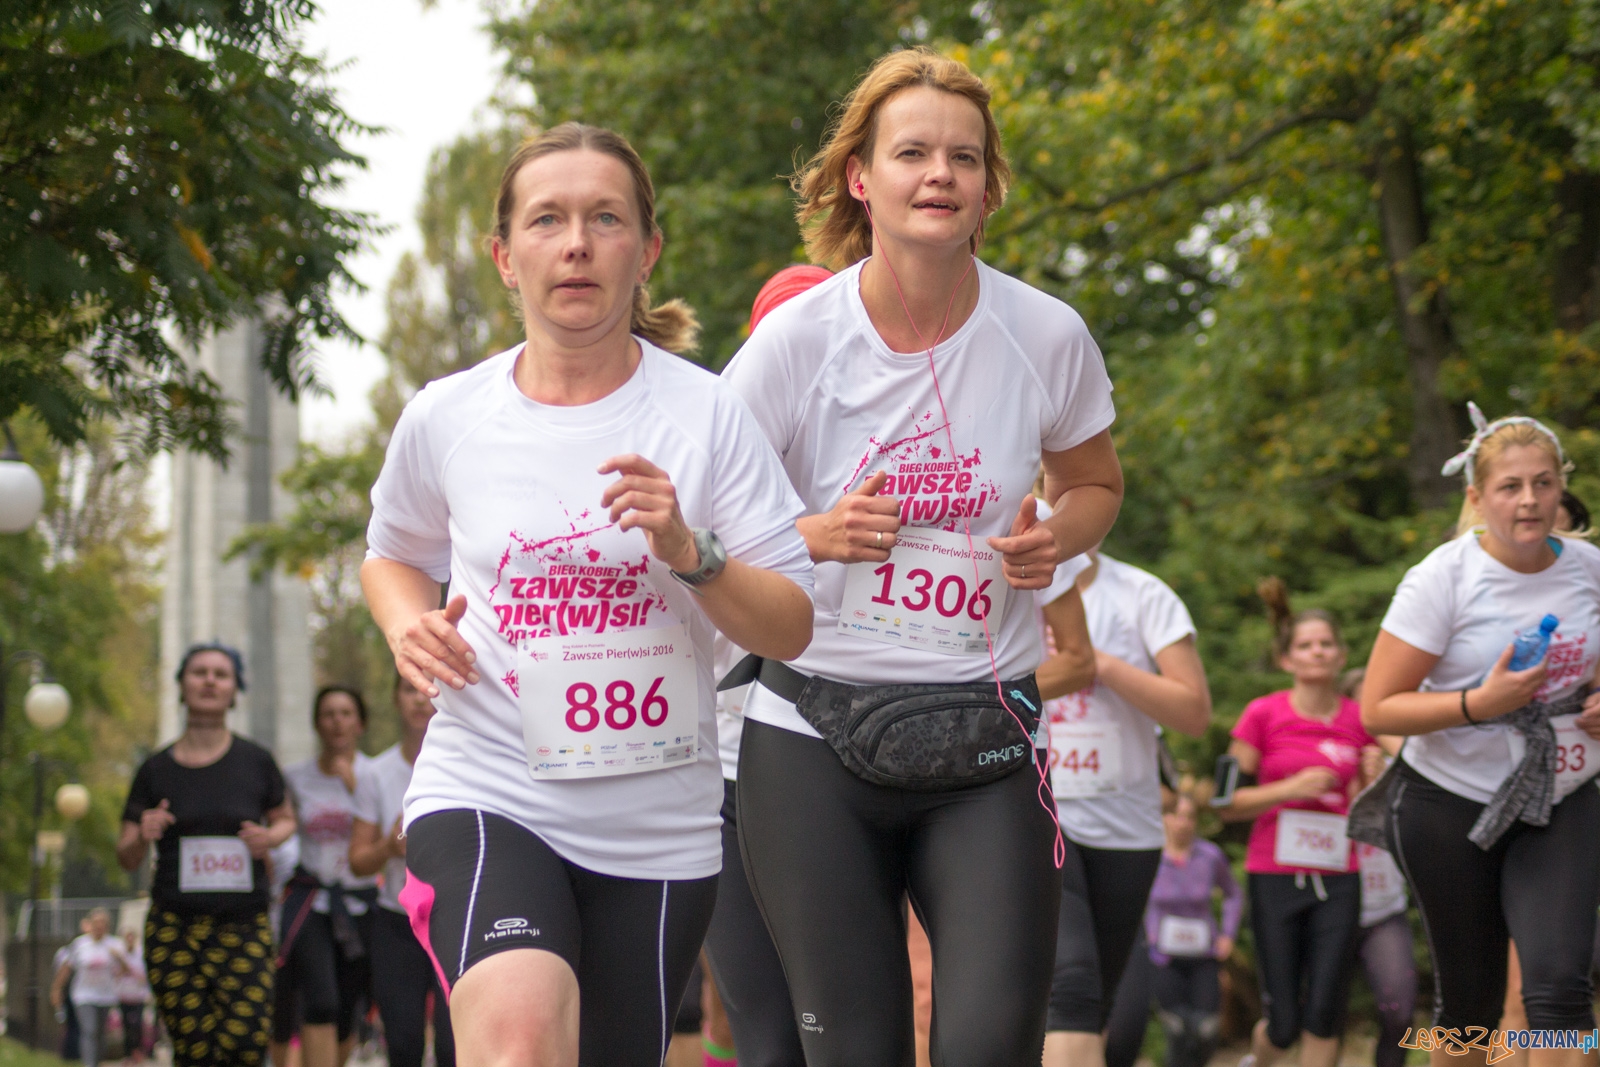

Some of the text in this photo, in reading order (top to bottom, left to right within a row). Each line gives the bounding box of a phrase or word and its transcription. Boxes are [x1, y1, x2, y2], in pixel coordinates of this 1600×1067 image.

[898, 461, 960, 474] BIEG KOBIET
[895, 538, 994, 561] Zawsze Pier(w)si 2016
[548, 564, 623, 578] BIEG KOBIET
[509, 576, 638, 600] zawsze
[871, 562, 994, 621] 1306
[493, 597, 654, 636] pier(w)si!
[562, 650, 604, 661] Zawsze
[606, 646, 650, 660] Pier(w)si
[652, 643, 674, 656] 2016
[565, 676, 669, 733] 886
[191, 853, 245, 874] 1040
[484, 928, 540, 941] Kalenji
